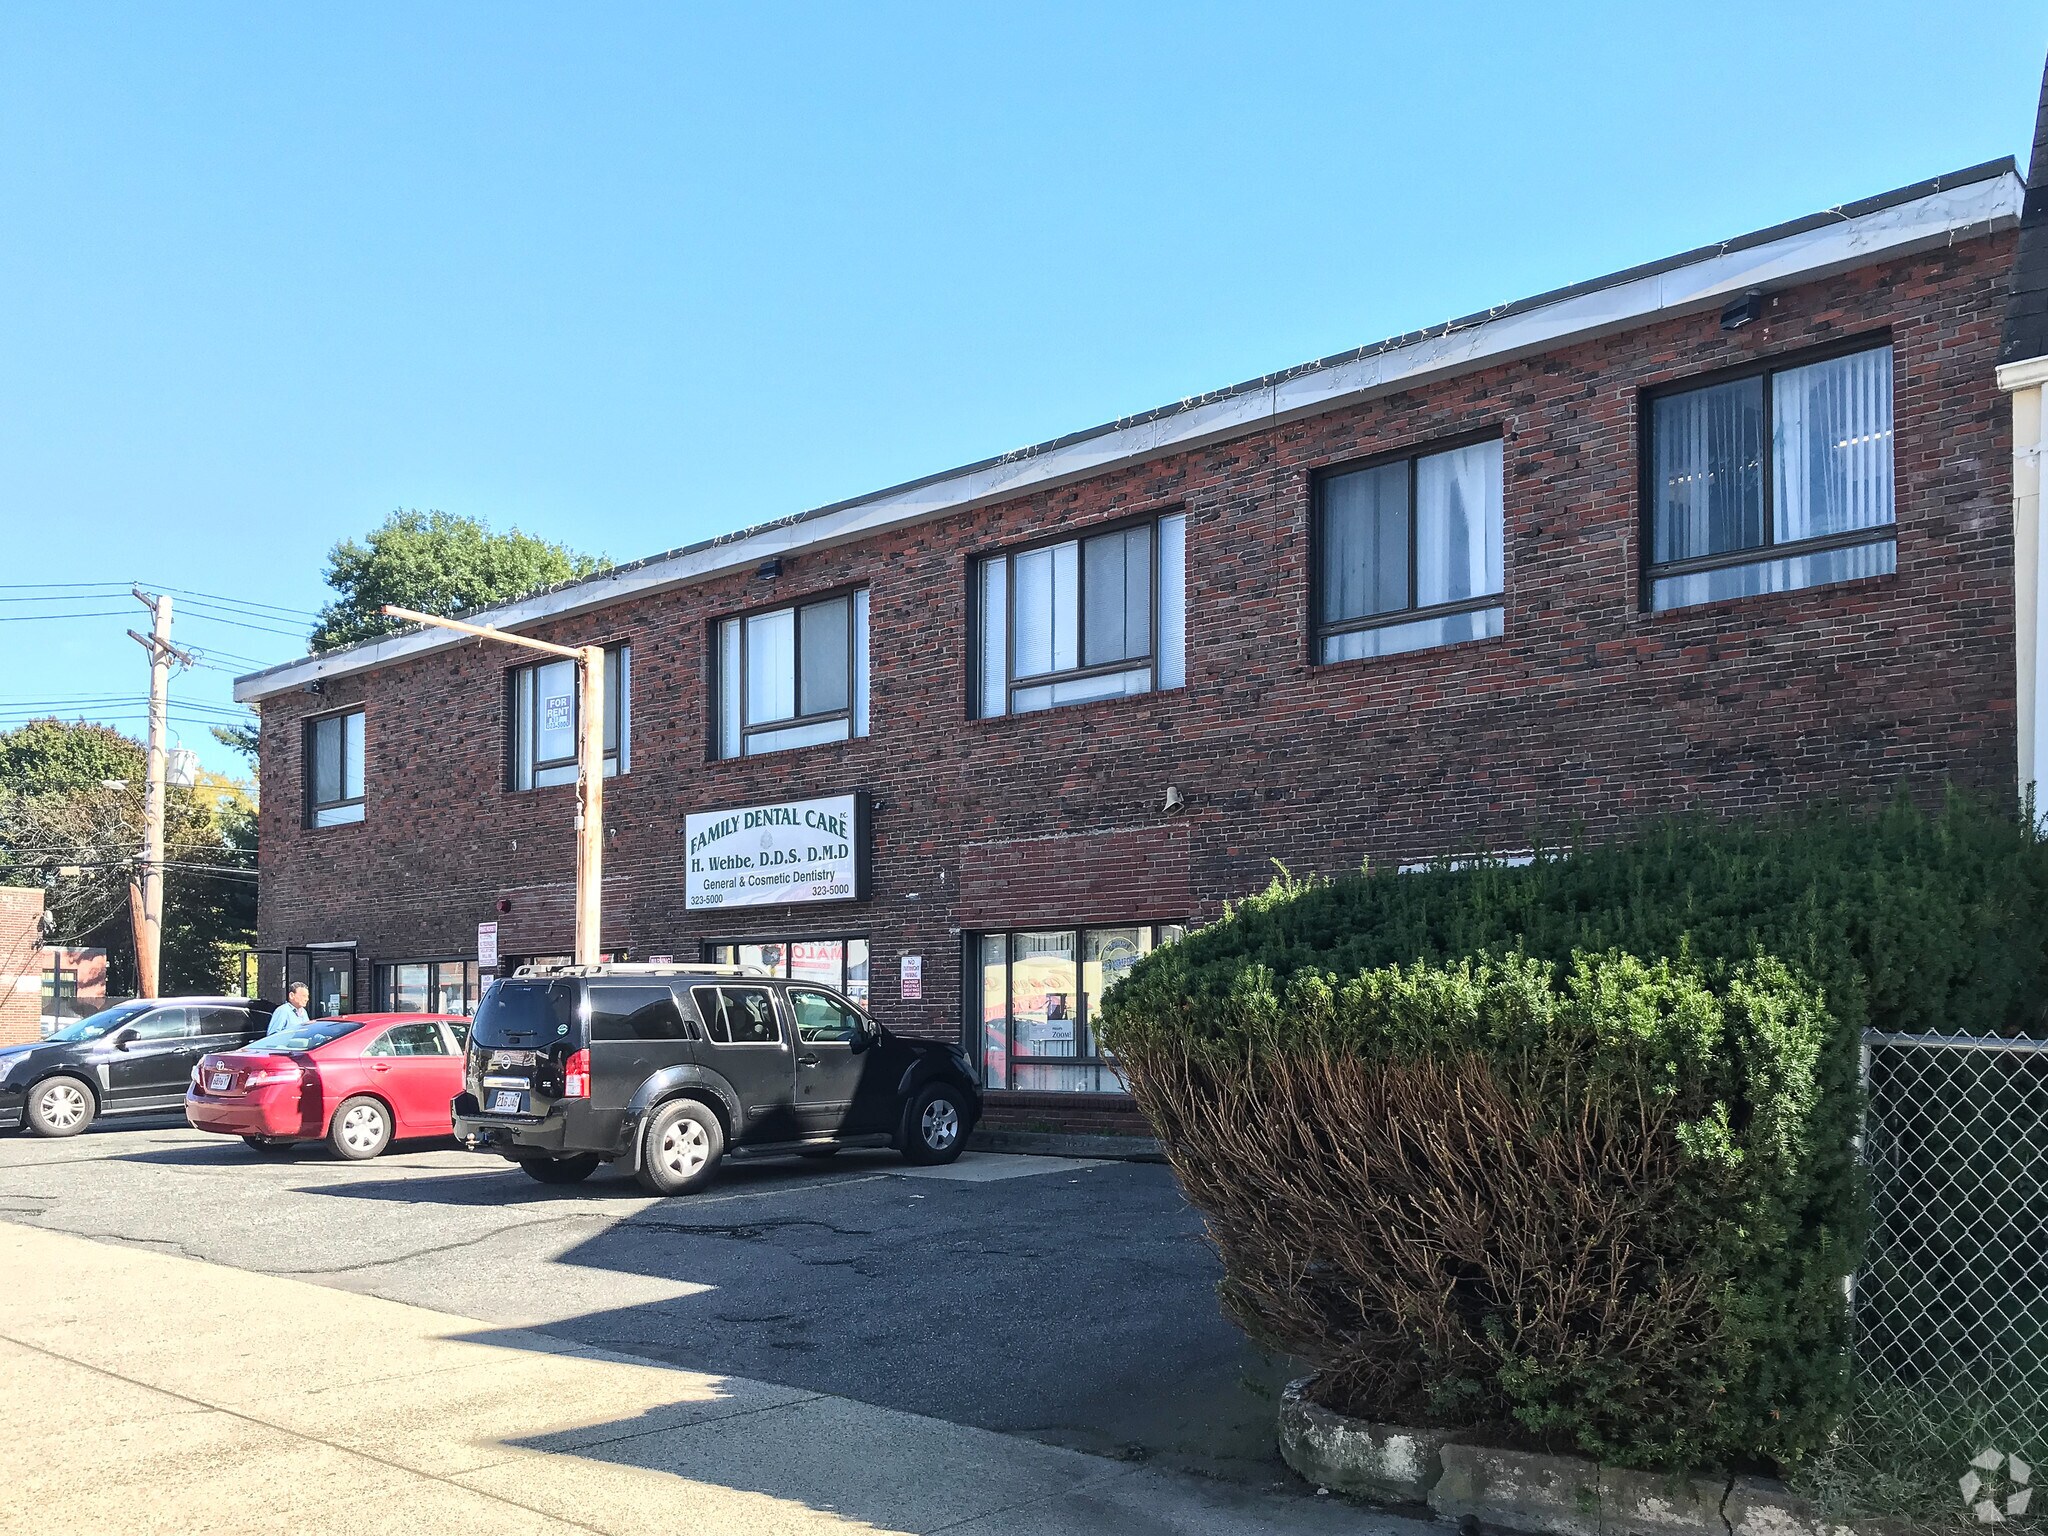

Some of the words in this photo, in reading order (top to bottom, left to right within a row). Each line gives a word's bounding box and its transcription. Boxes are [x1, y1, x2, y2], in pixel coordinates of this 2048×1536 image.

[550, 698, 567, 708] FOR
[547, 706, 570, 718] RENT
[691, 815, 740, 856] FAMILY
[744, 807, 801, 830] DENTAL
[805, 810, 849, 840] CARE
[691, 858, 704, 873] H.
[709, 854, 755, 871] Wehbe,
[760, 848, 801, 867] D.D.S.
[807, 844, 849, 862] D.M.D
[703, 877, 737, 890] General
[739, 876, 746, 888] &
[748, 872, 791, 887] Cosmetic
[793, 869, 835, 883] Dentistry
[812, 884, 849, 896] 323-5000
[691, 894, 723, 906] 323-5000
